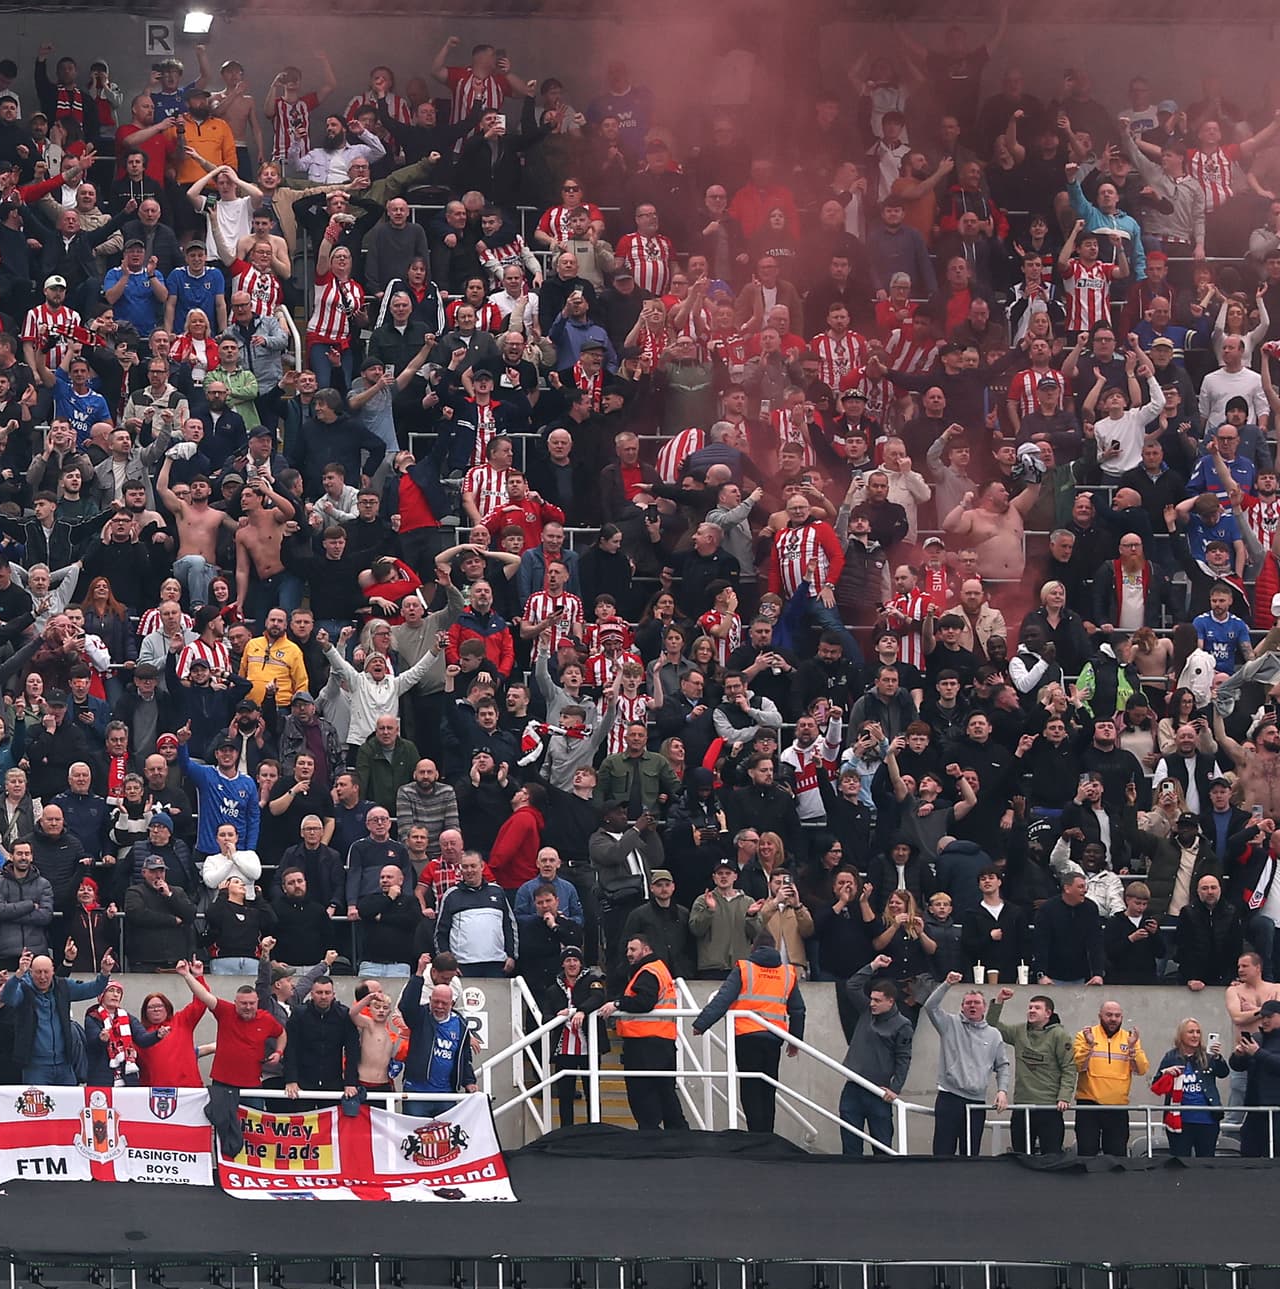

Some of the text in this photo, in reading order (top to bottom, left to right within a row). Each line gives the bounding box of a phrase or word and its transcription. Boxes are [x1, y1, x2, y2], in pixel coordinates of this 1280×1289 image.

[148, 25, 170, 51] R
[220, 804, 240, 819] W88
[433, 1048, 453, 1061] W88
[128, 1149, 197, 1163] EASINGTON
[275, 1143, 320, 1160] Lads
[17, 1158, 68, 1175] FTM
[146, 1164, 179, 1175] BOYS
[228, 1173, 289, 1188] SAFC
